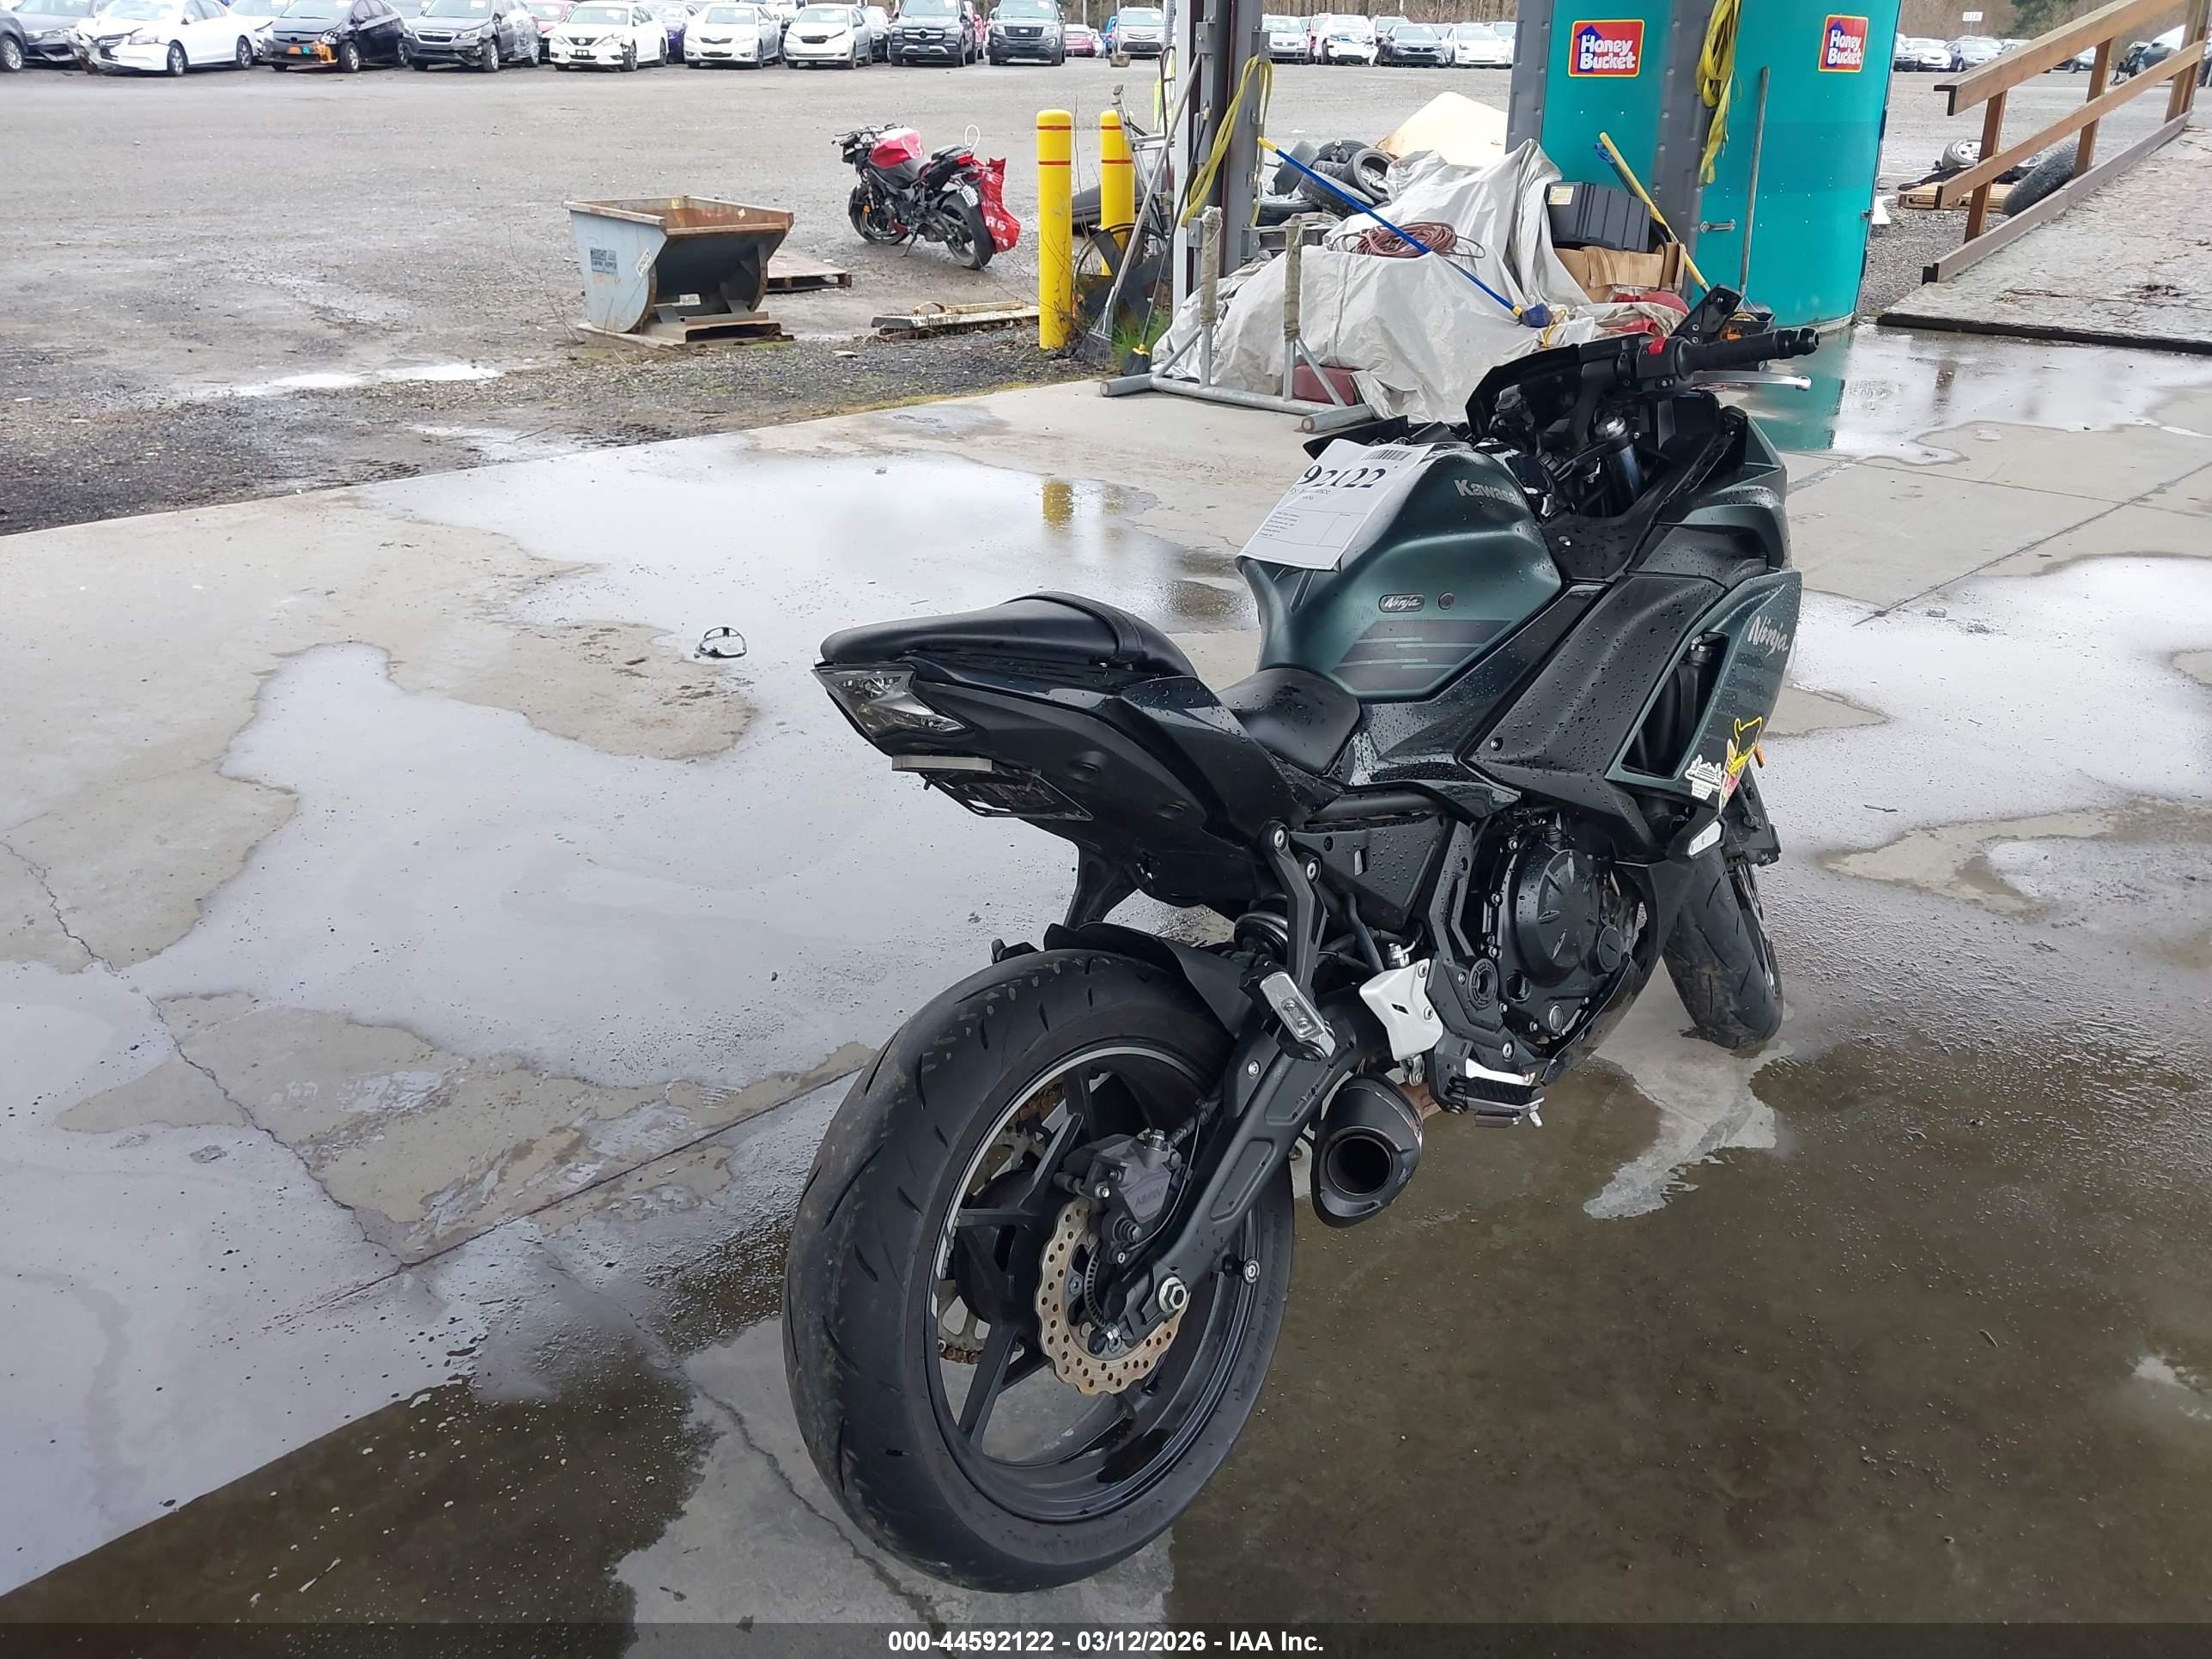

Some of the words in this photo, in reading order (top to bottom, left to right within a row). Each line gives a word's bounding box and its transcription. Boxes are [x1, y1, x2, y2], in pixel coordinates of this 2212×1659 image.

[1581, 34, 1633, 56] Honey
[1830, 29, 1862, 52] Honey
[1580, 52, 1636, 69] Bucket
[1827, 48, 1862, 64] Bucket
[1297, 465, 1387, 489] 92122
[1383, 595, 1421, 611] Ninja
[1747, 615, 1789, 658] Ninja
